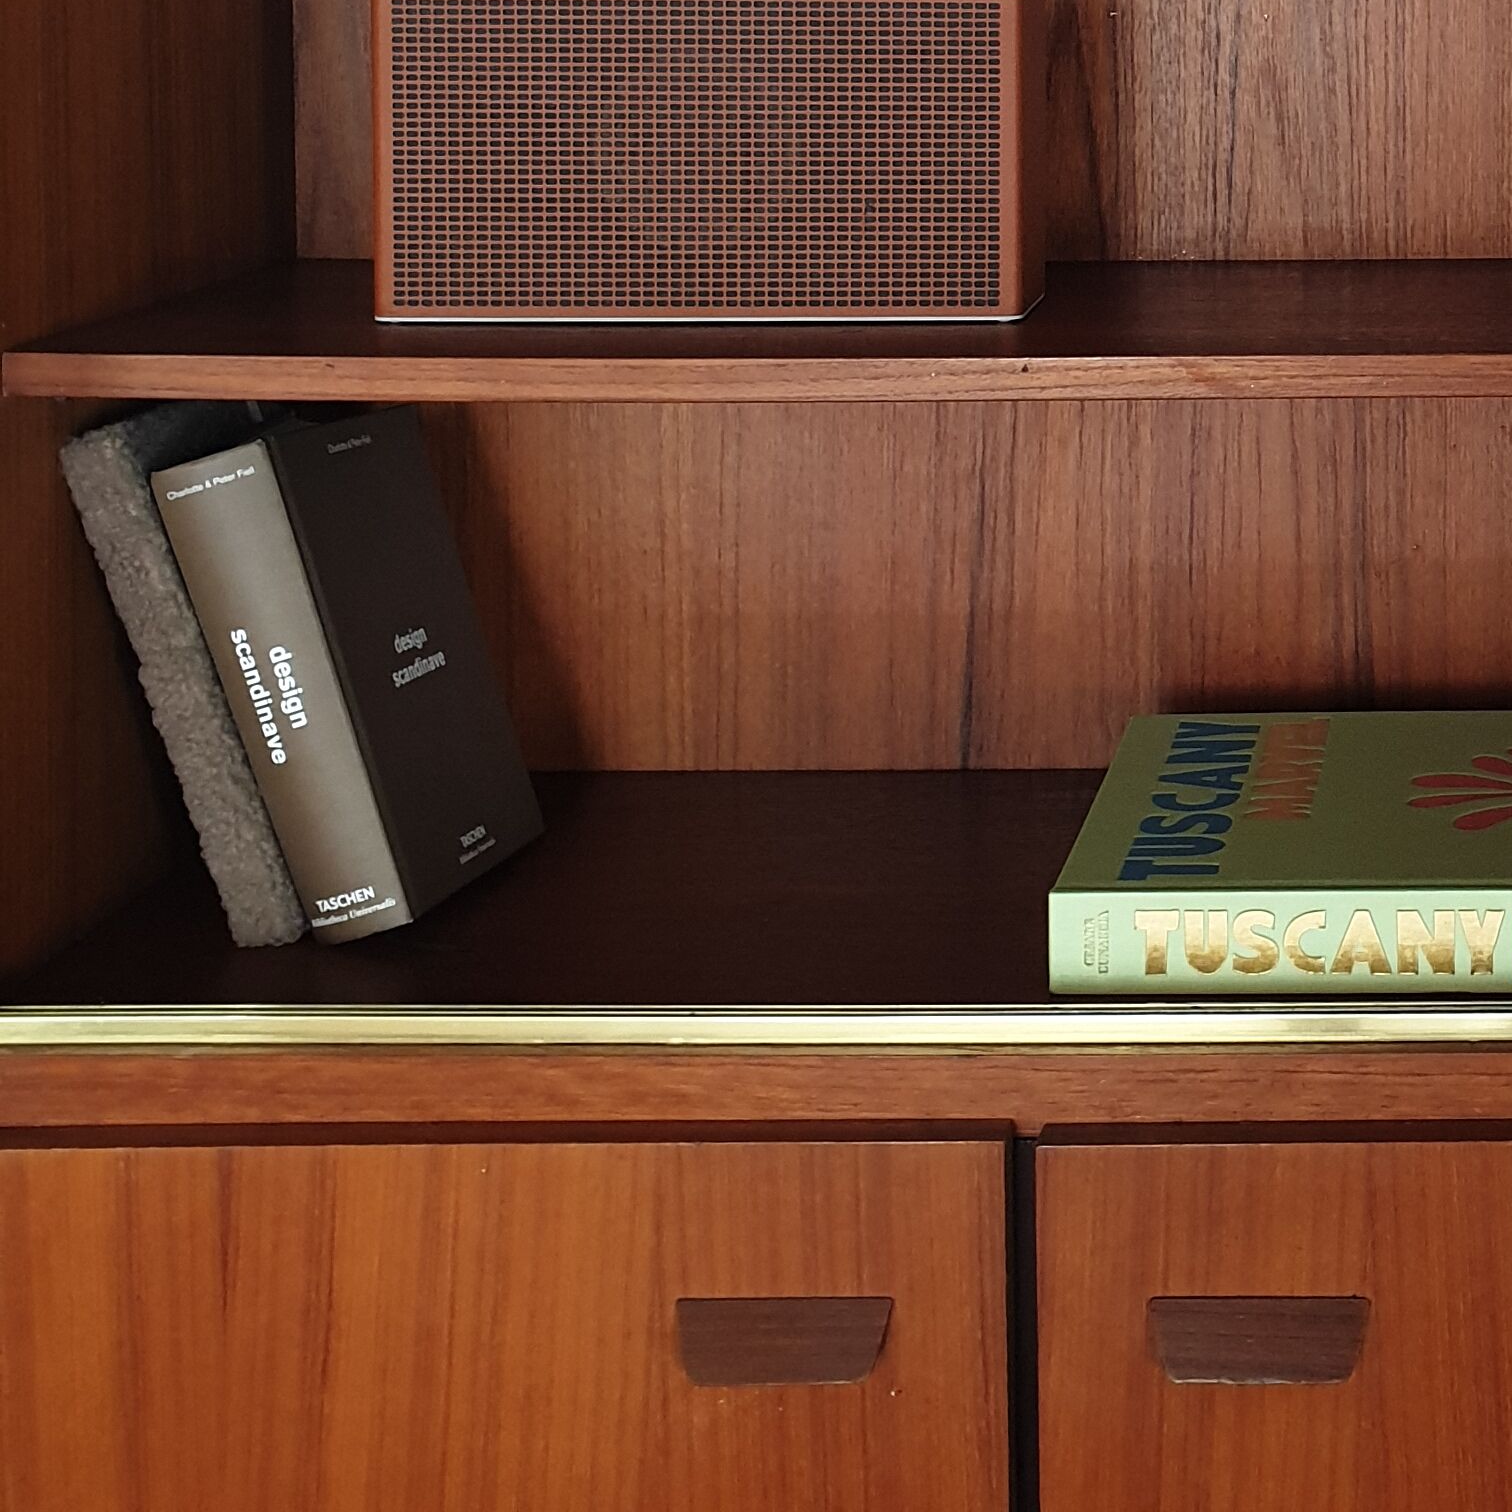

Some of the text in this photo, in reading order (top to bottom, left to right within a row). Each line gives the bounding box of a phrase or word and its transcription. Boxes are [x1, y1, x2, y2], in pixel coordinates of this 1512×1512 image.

[392, 651, 446, 688] scandinave
[394, 628, 428, 654] design
[230, 628, 287, 764] scandinave
[269, 646, 308, 729] design
[1117, 722, 1261, 881] TUSCANY
[315, 886, 375, 913] TASCHEN
[1134, 909, 1505, 975] TUSCANY
